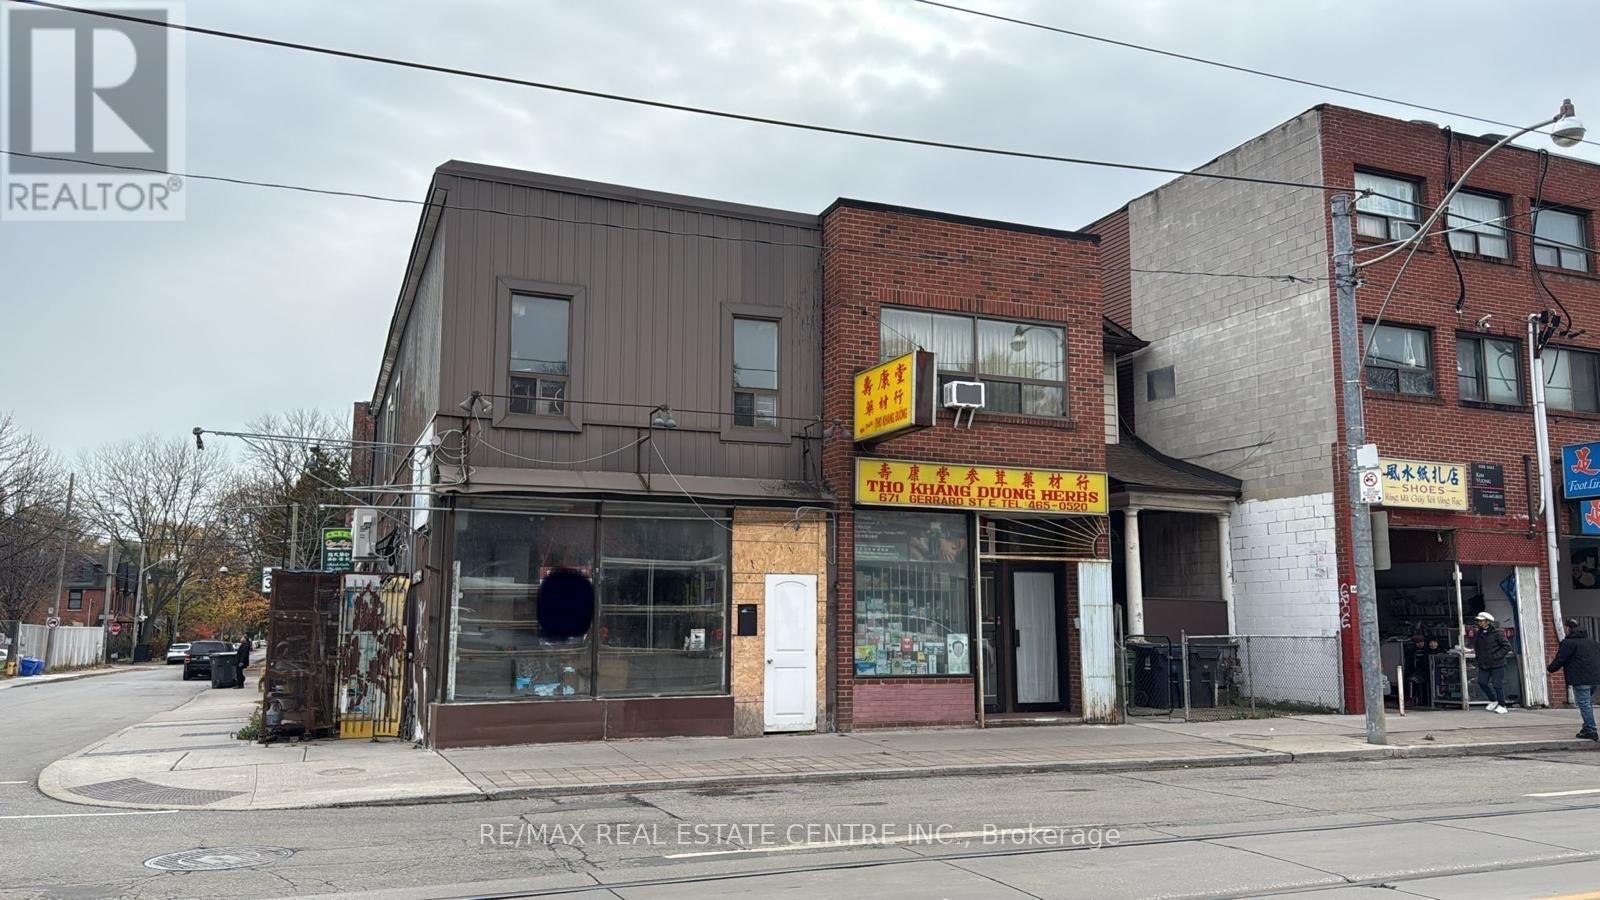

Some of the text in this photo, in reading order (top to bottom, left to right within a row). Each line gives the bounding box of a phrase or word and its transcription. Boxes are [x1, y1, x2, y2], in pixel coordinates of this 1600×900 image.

[866, 480, 1099, 504] THO KHANG DUONG HERBS
[1402, 484, 1445, 495] SHOES
[879, 493, 899, 503] 671
[909, 494, 964, 506] GERRARD
[1028, 501, 1088, 512] 465-0520
